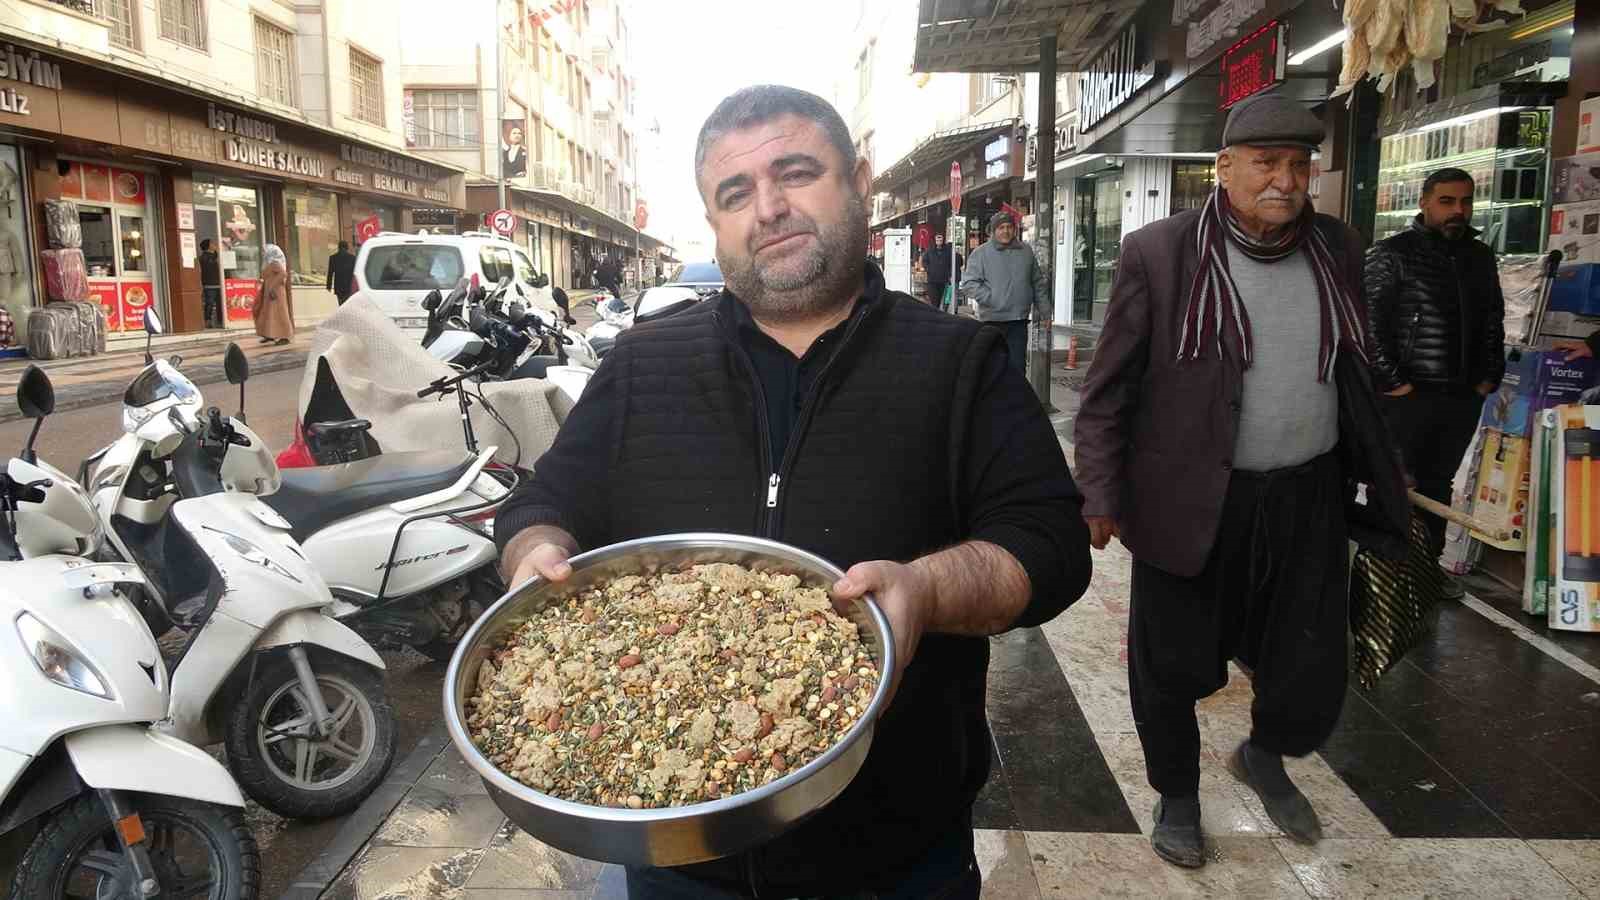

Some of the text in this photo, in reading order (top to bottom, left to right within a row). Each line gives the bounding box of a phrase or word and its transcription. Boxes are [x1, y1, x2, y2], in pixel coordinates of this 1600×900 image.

[208, 103, 279, 144] İSTANBUL
[227, 137, 325, 178] DÖNER SALONU
[1551, 366, 1584, 379] Vortex
[1561, 590, 1578, 625] CVS
